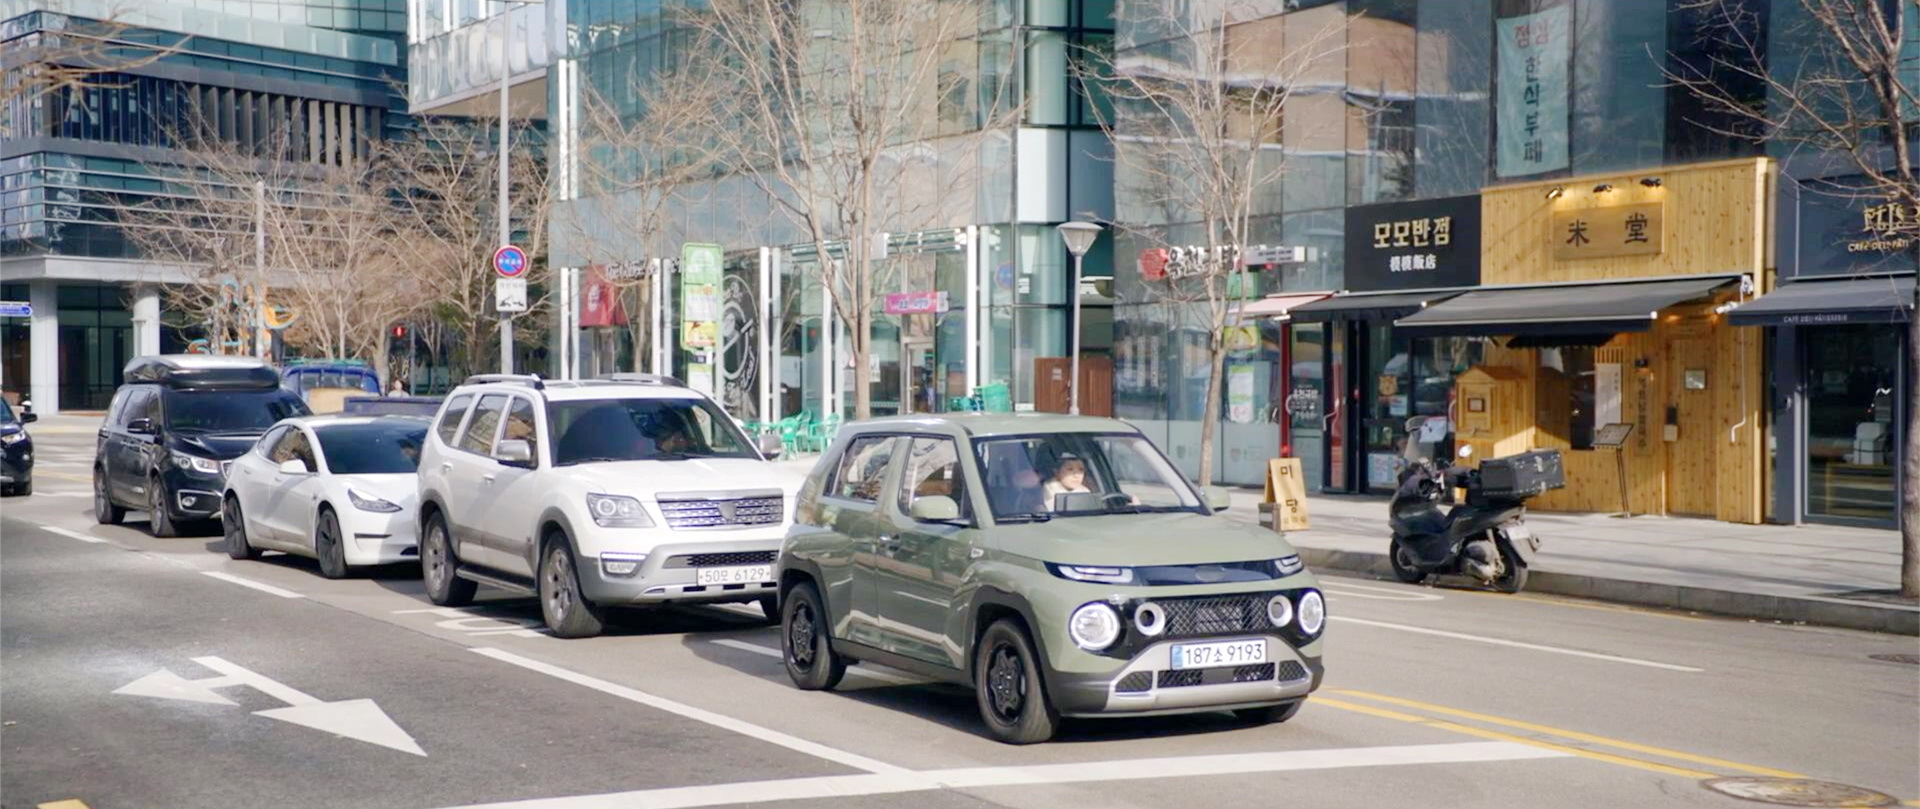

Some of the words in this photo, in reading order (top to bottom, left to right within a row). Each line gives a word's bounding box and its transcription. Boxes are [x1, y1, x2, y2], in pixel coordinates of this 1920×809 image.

[1373, 216, 1452, 249] 모모반점
[735, 567, 765, 581] 6129
[1186, 647, 1223, 665] 187소
[1227, 644, 1262, 661] 9193
